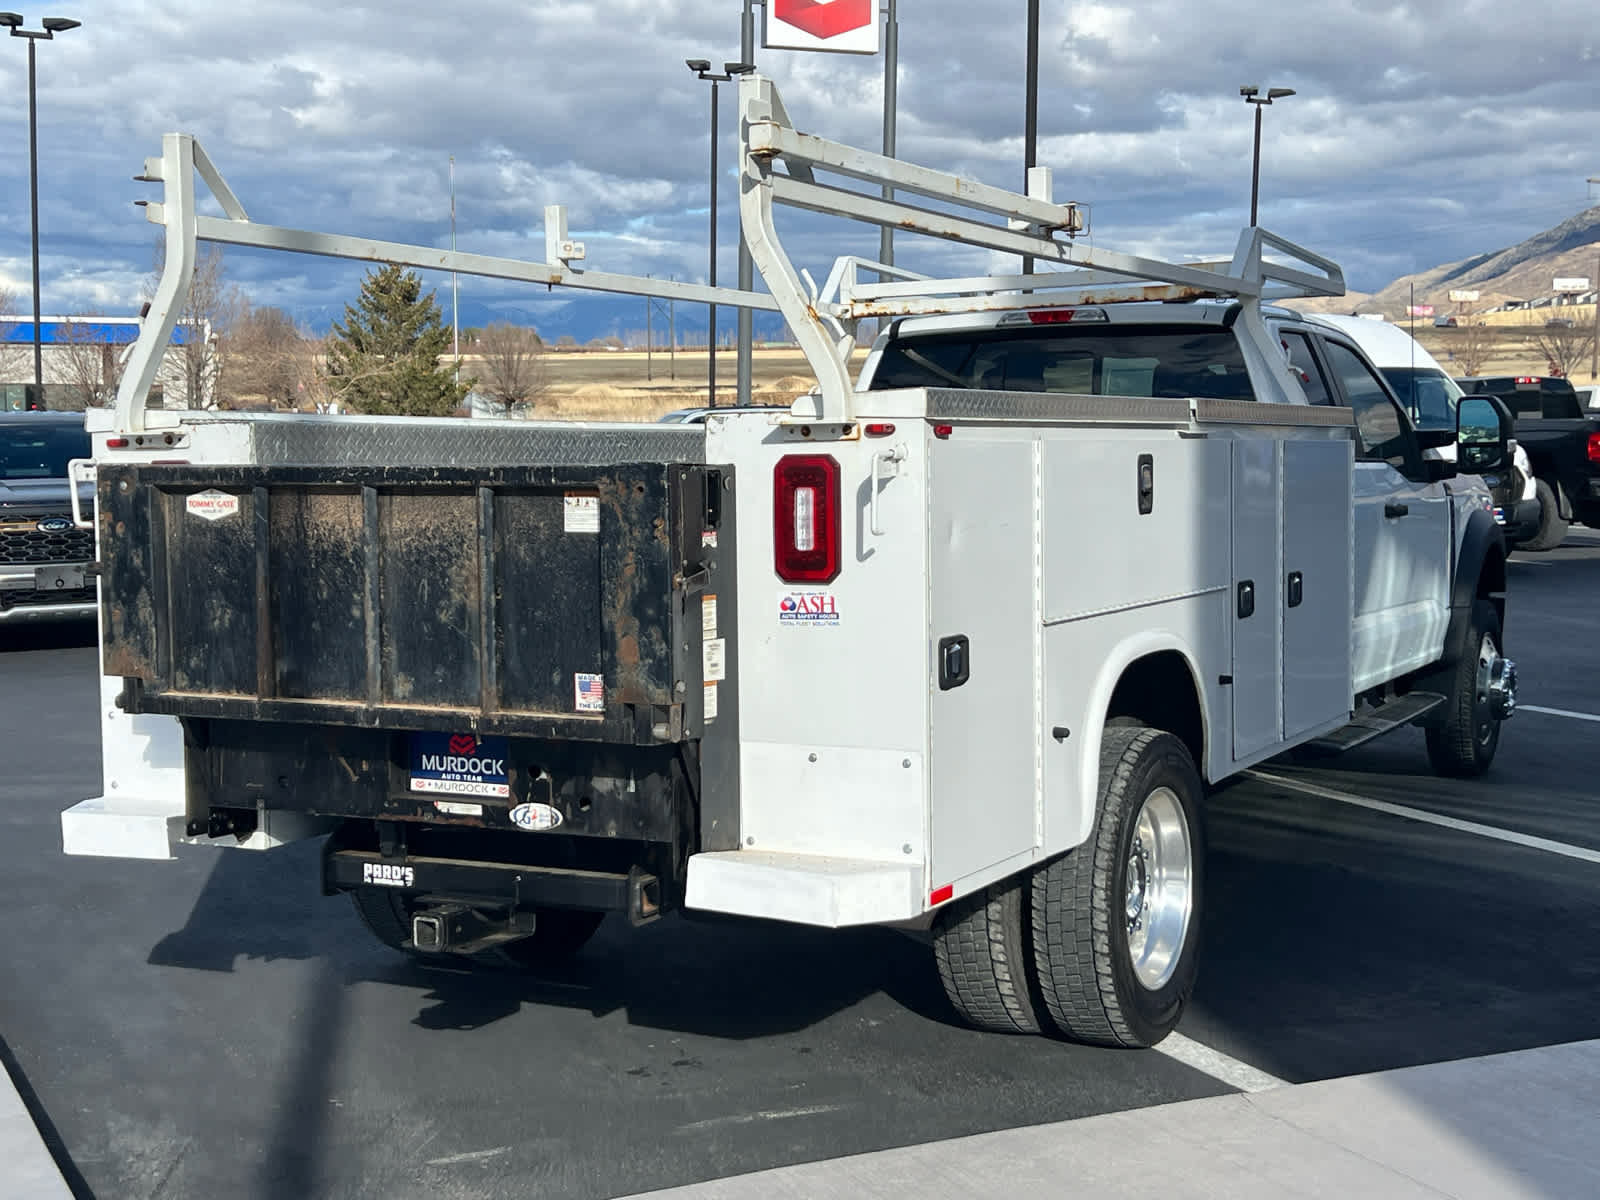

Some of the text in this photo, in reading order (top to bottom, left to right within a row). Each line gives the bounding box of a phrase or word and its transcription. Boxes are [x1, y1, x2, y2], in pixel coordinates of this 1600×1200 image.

[188, 499, 234, 508] TOMMY GATE
[796, 595, 835, 613] ASH
[421, 754, 505, 776] MURDOCK
[441, 772, 483, 782] AUTO TEAM
[434, 781, 489, 794] MURDOCK
